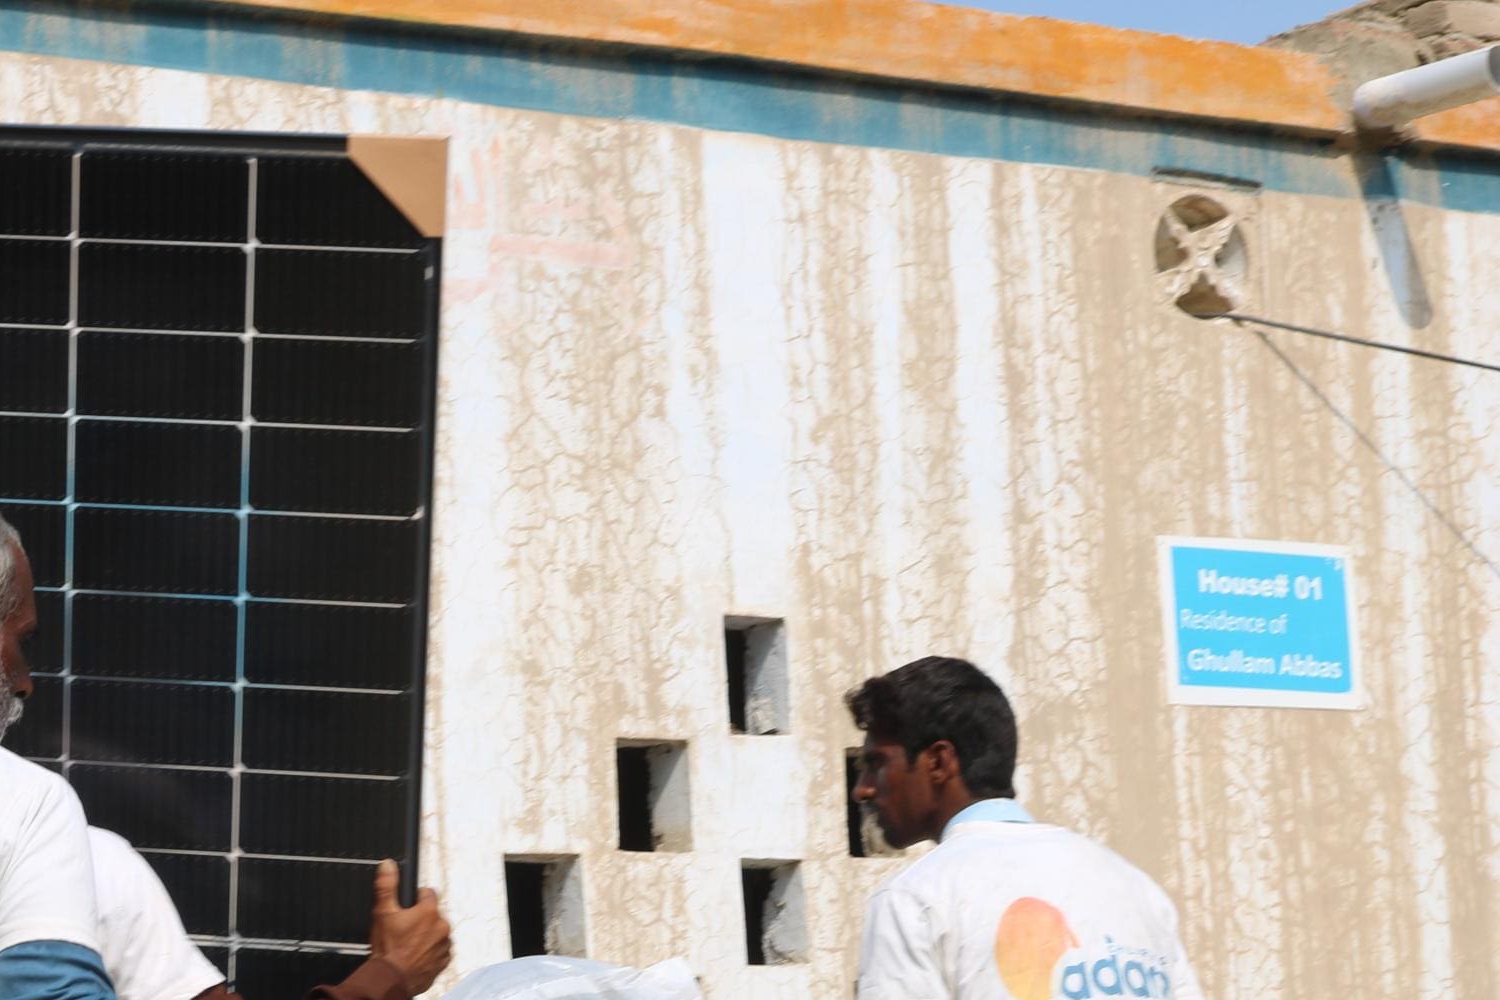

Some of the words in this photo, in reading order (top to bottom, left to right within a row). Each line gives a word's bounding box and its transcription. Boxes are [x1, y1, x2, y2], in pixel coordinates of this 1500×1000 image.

[1197, 568, 1289, 599] House#
[1293, 575, 1324, 601] 01
[1179, 608, 1267, 634] Residence
[1268, 613, 1289, 635] of
[1279, 654, 1344, 680] Abbas
